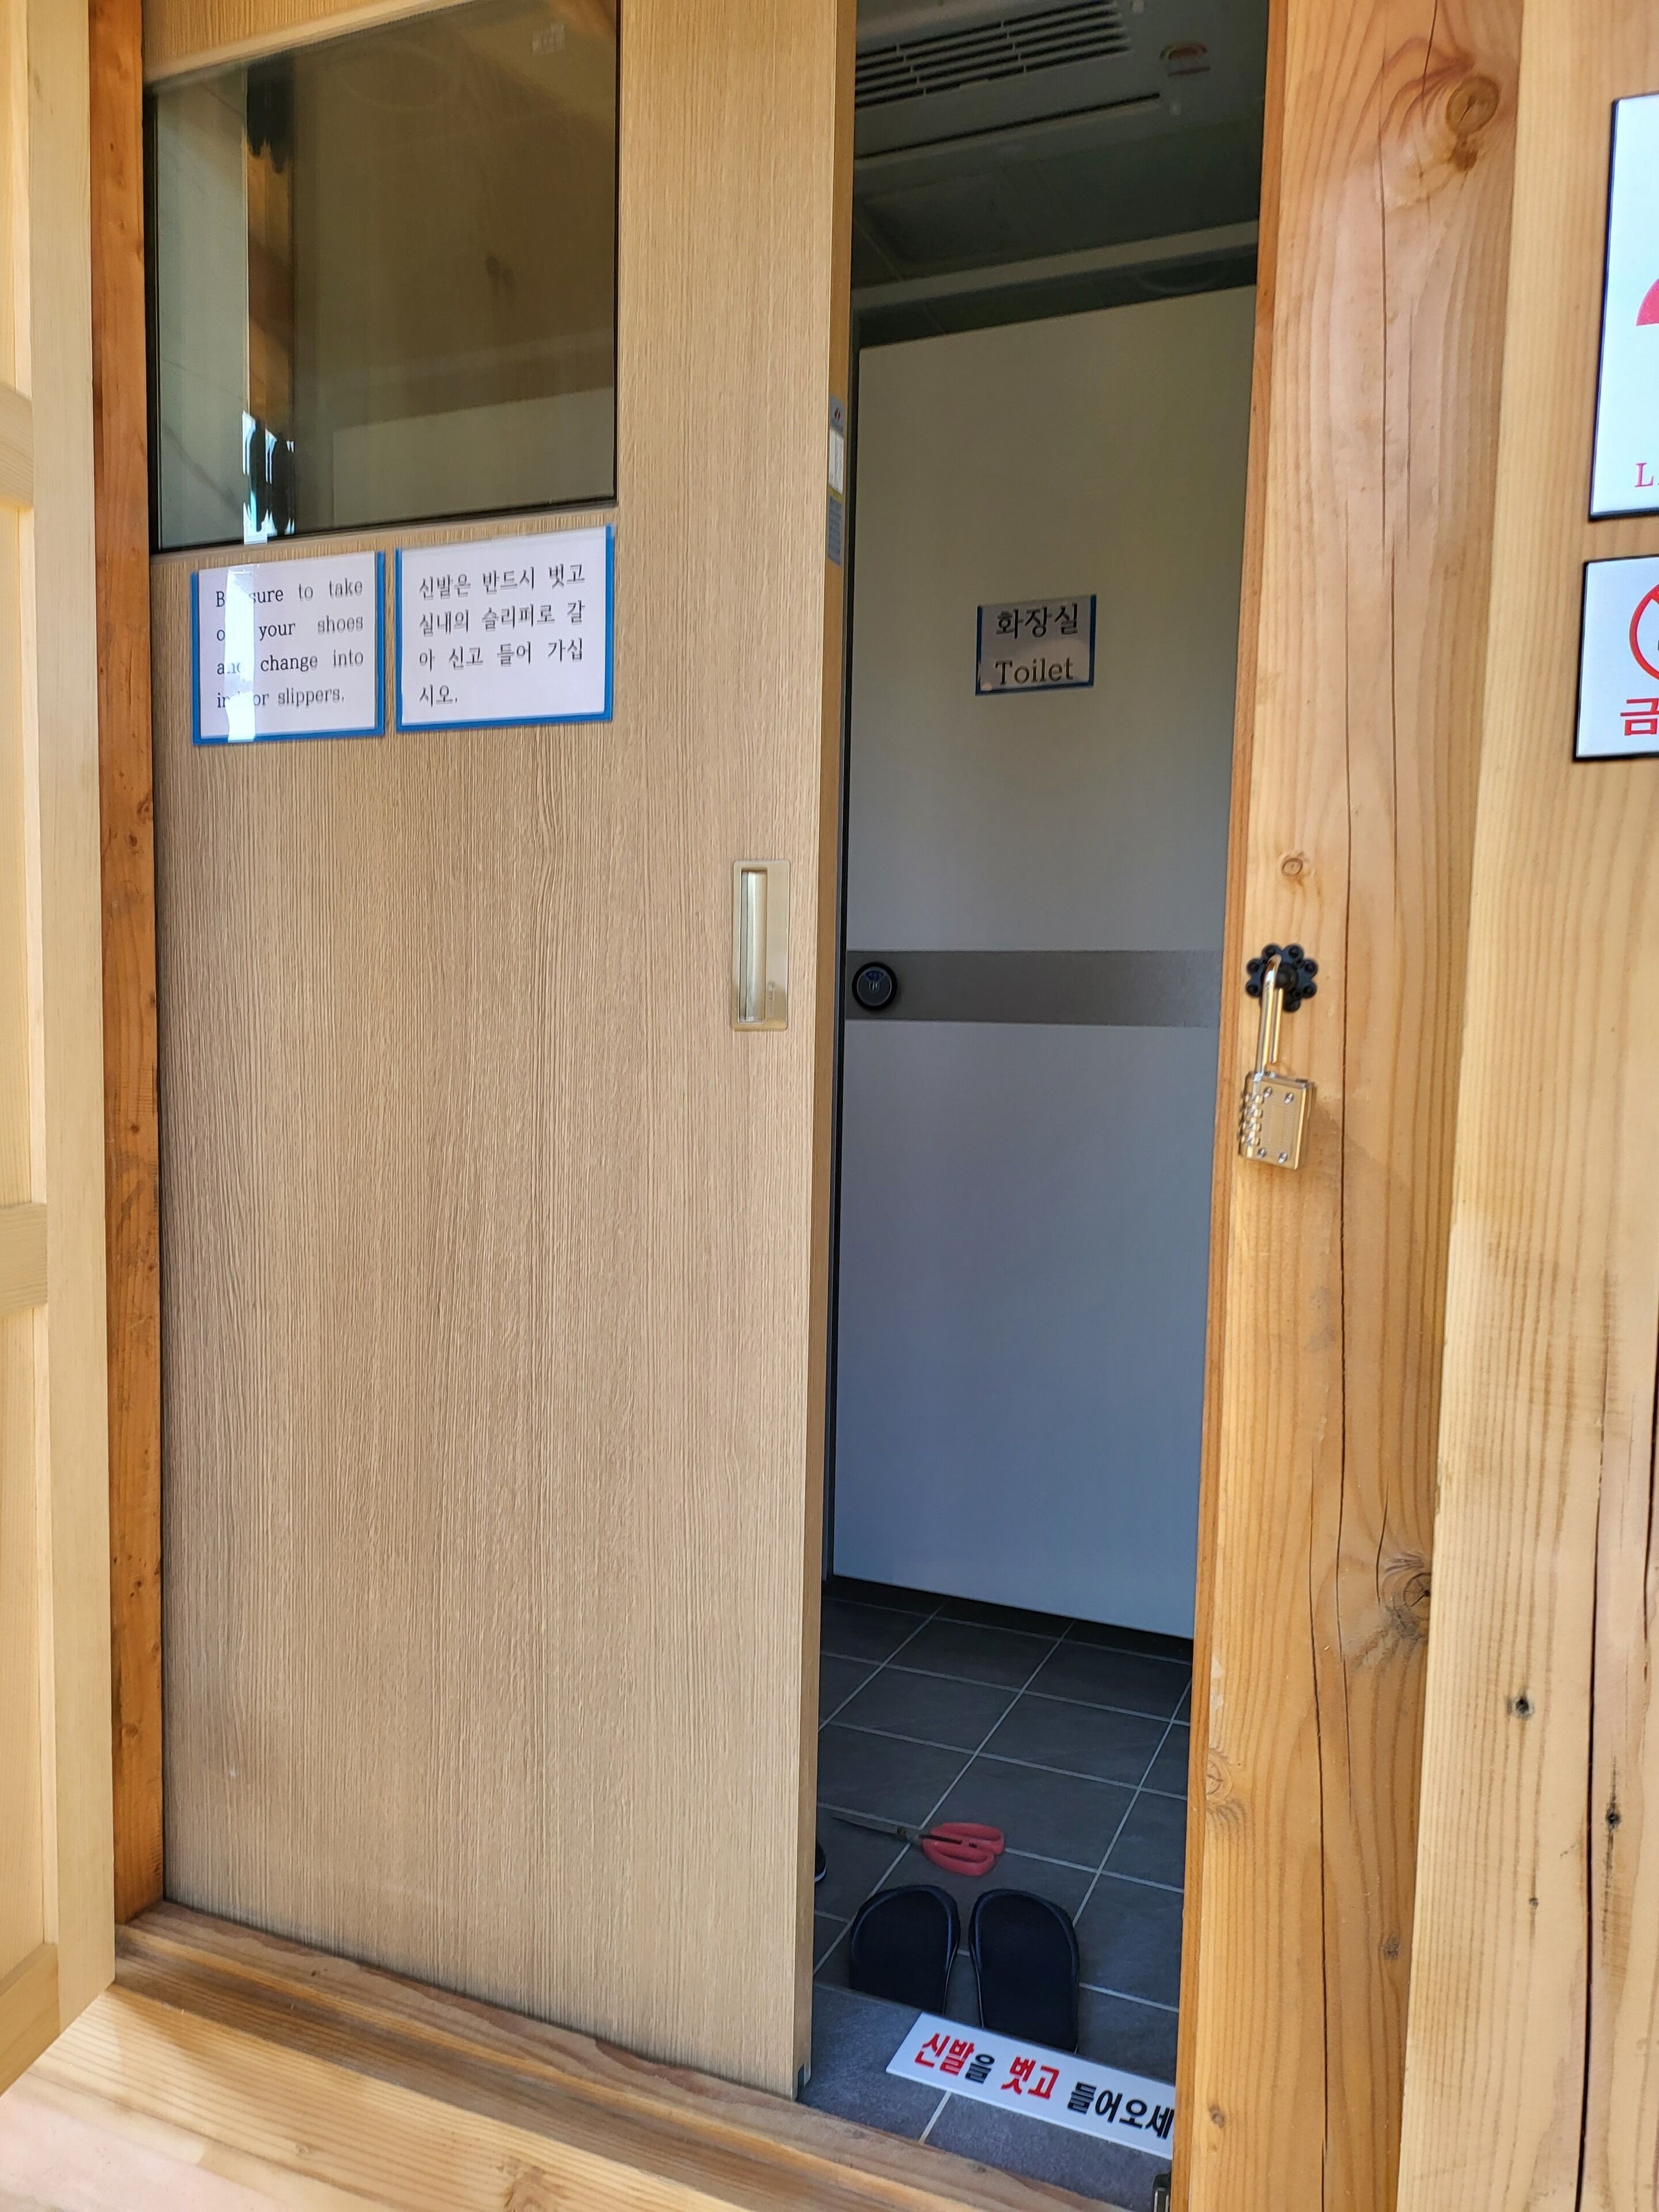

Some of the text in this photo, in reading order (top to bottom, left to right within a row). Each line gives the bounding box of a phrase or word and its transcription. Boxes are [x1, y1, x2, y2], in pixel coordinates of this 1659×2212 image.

[249, 589, 283, 604] sure
[298, 582, 313, 601] to
[328, 577, 363, 599] take
[419, 563, 585, 600] 신발은 반드시 벗고
[259, 622, 296, 641] your
[317, 615, 363, 634] shoes
[419, 608, 469, 637] 실내의
[566, 600, 585, 626] 갈
[996, 602, 1078, 639] 화장실
[260, 654, 318, 672] change
[332, 649, 363, 667] into
[419, 637, 584, 673] 아 신고 들어 가십
[995, 657, 1074, 685] Toilet
[278, 687, 344, 709] slippers.
[419, 684, 459, 707] 시오.
[914, 2032, 995, 2084] 신발을
[1001, 2055, 1060, 2100] 벗고
